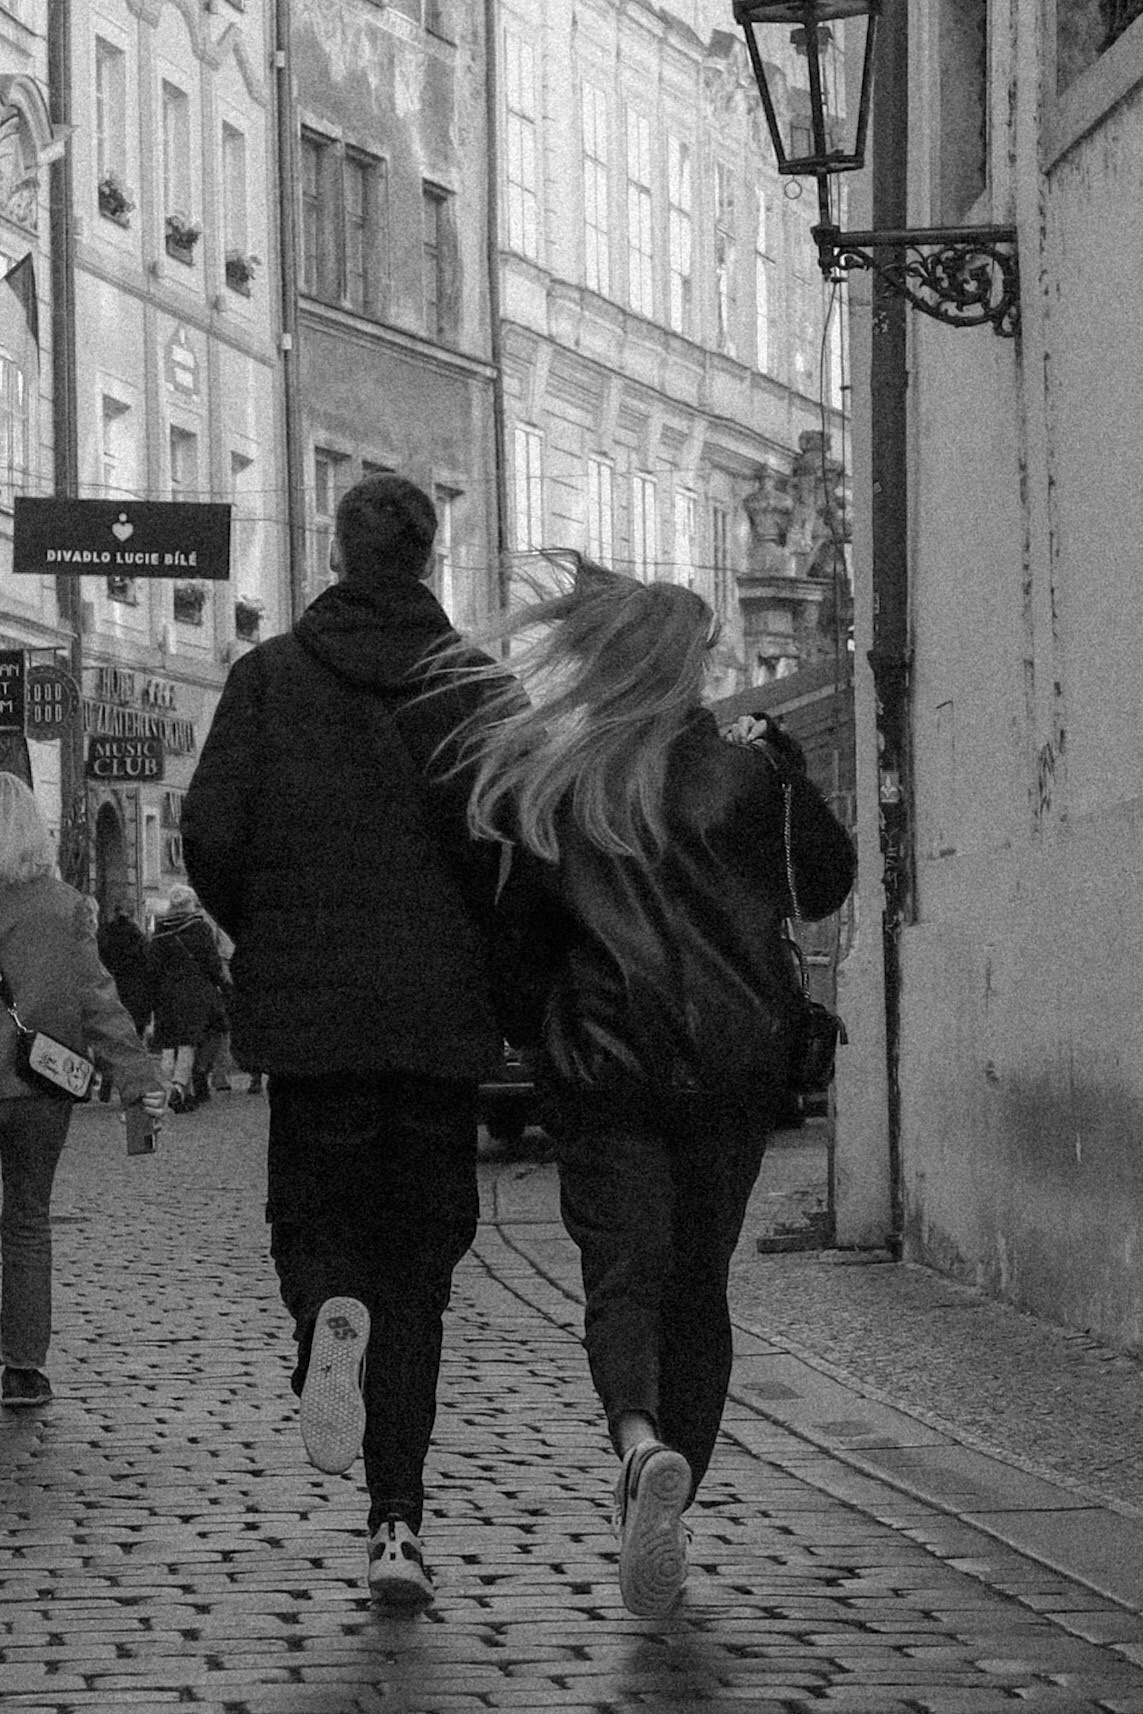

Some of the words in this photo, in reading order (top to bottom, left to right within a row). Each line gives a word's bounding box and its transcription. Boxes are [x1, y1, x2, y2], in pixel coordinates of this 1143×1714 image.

[46, 549, 112, 564] DIVADLO
[115, 551, 160, 566] LUCIE
[163, 550, 198, 567] BÍLÉ
[95, 742, 155, 757] MUSIC
[93, 757, 158, 776] CLUB
